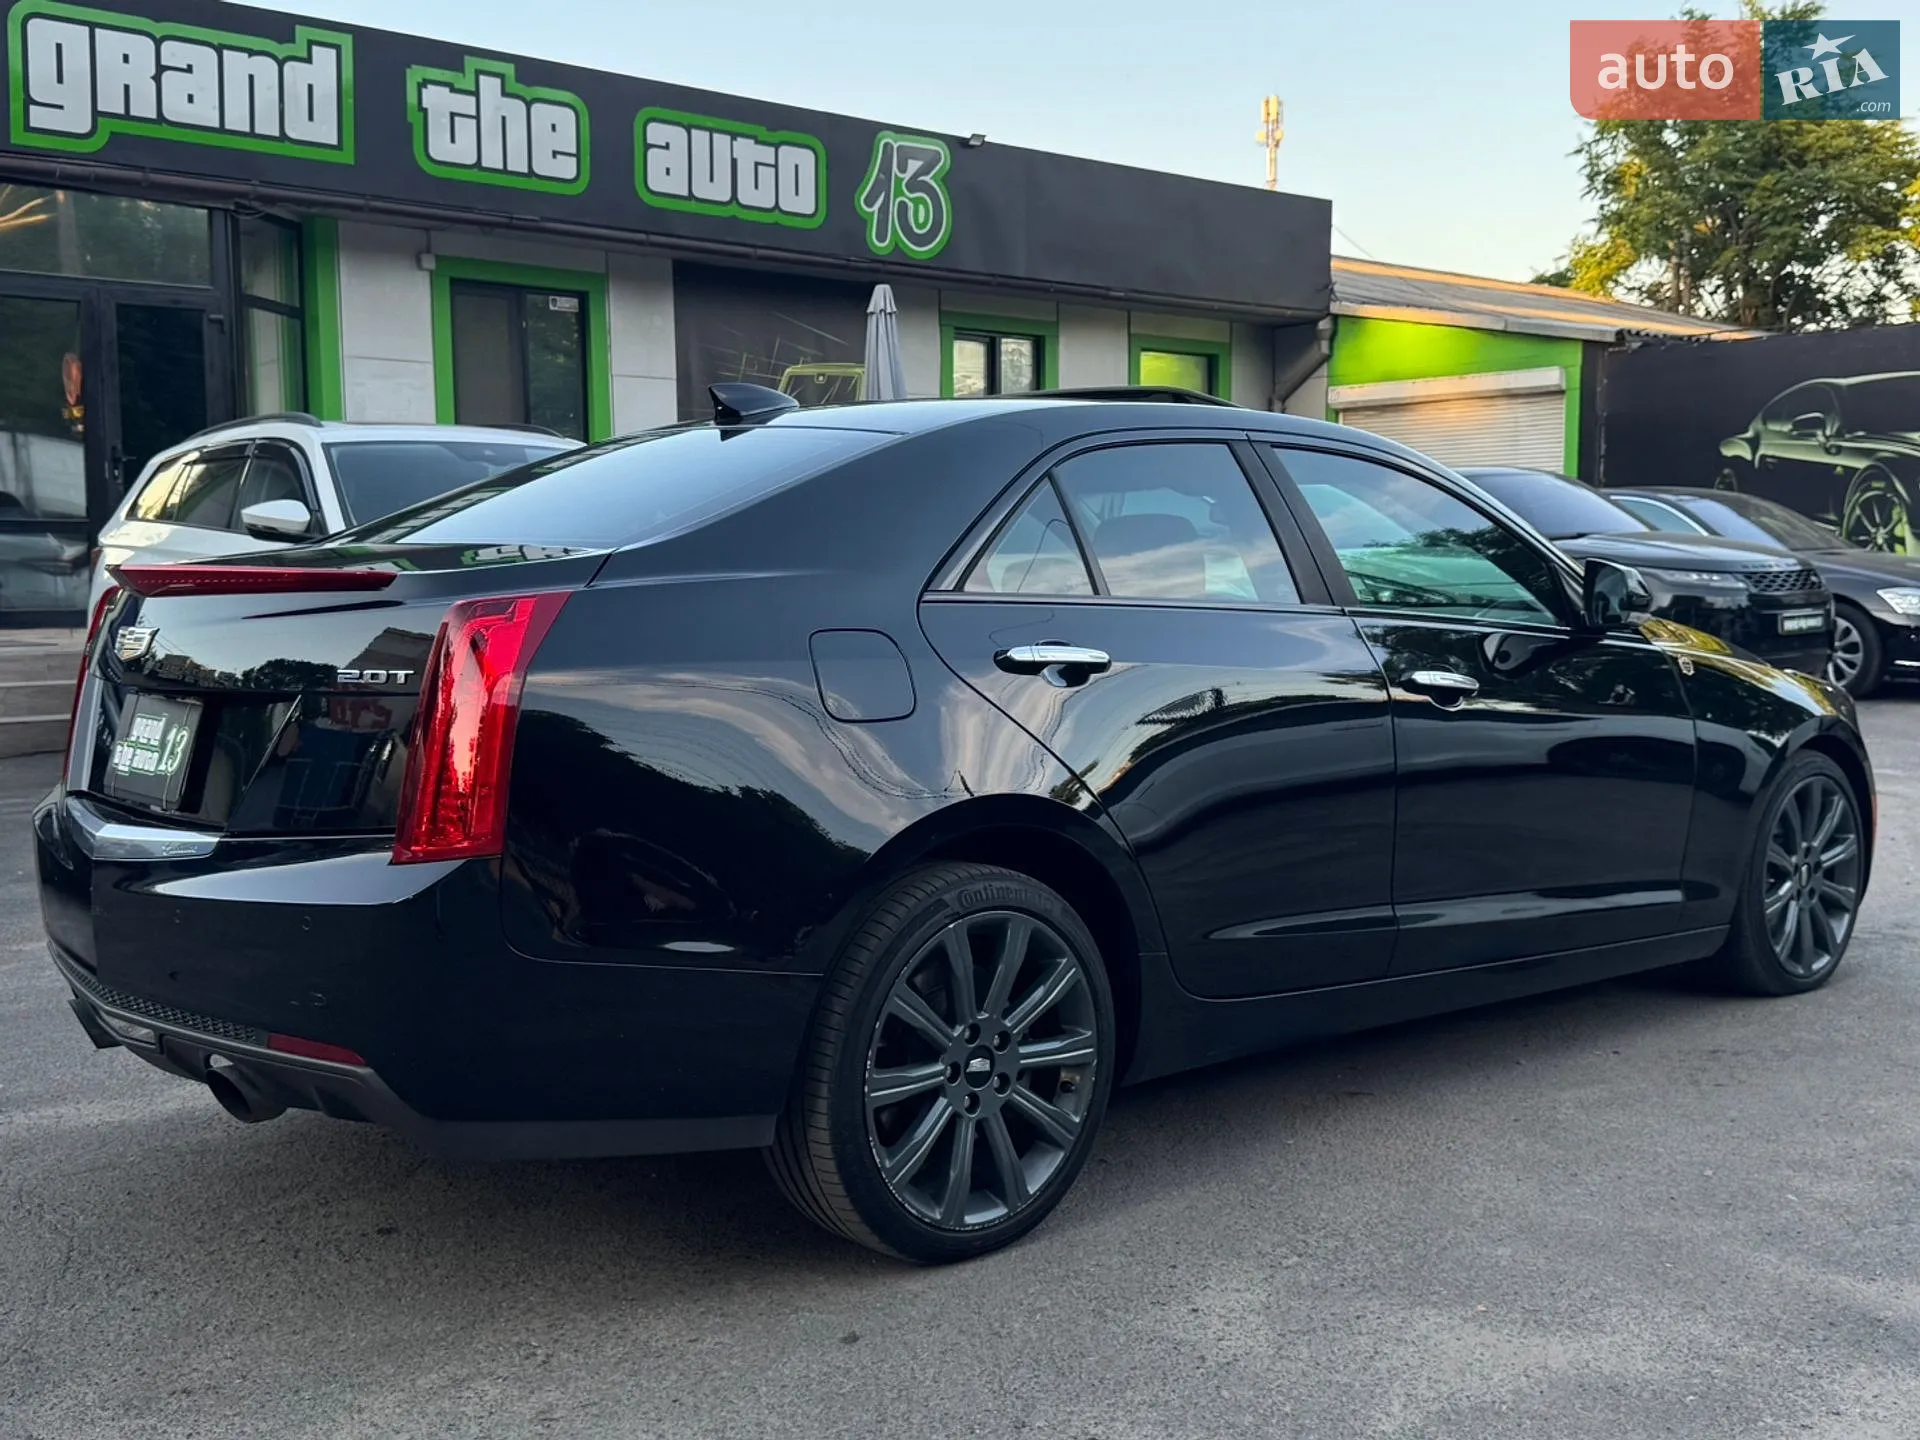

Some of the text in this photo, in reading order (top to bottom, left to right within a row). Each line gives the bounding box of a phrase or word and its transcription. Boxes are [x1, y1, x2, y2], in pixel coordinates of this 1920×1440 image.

[421, 73, 578, 181] the
[646, 121, 816, 215] auto
[859, 137, 948, 252] 13
